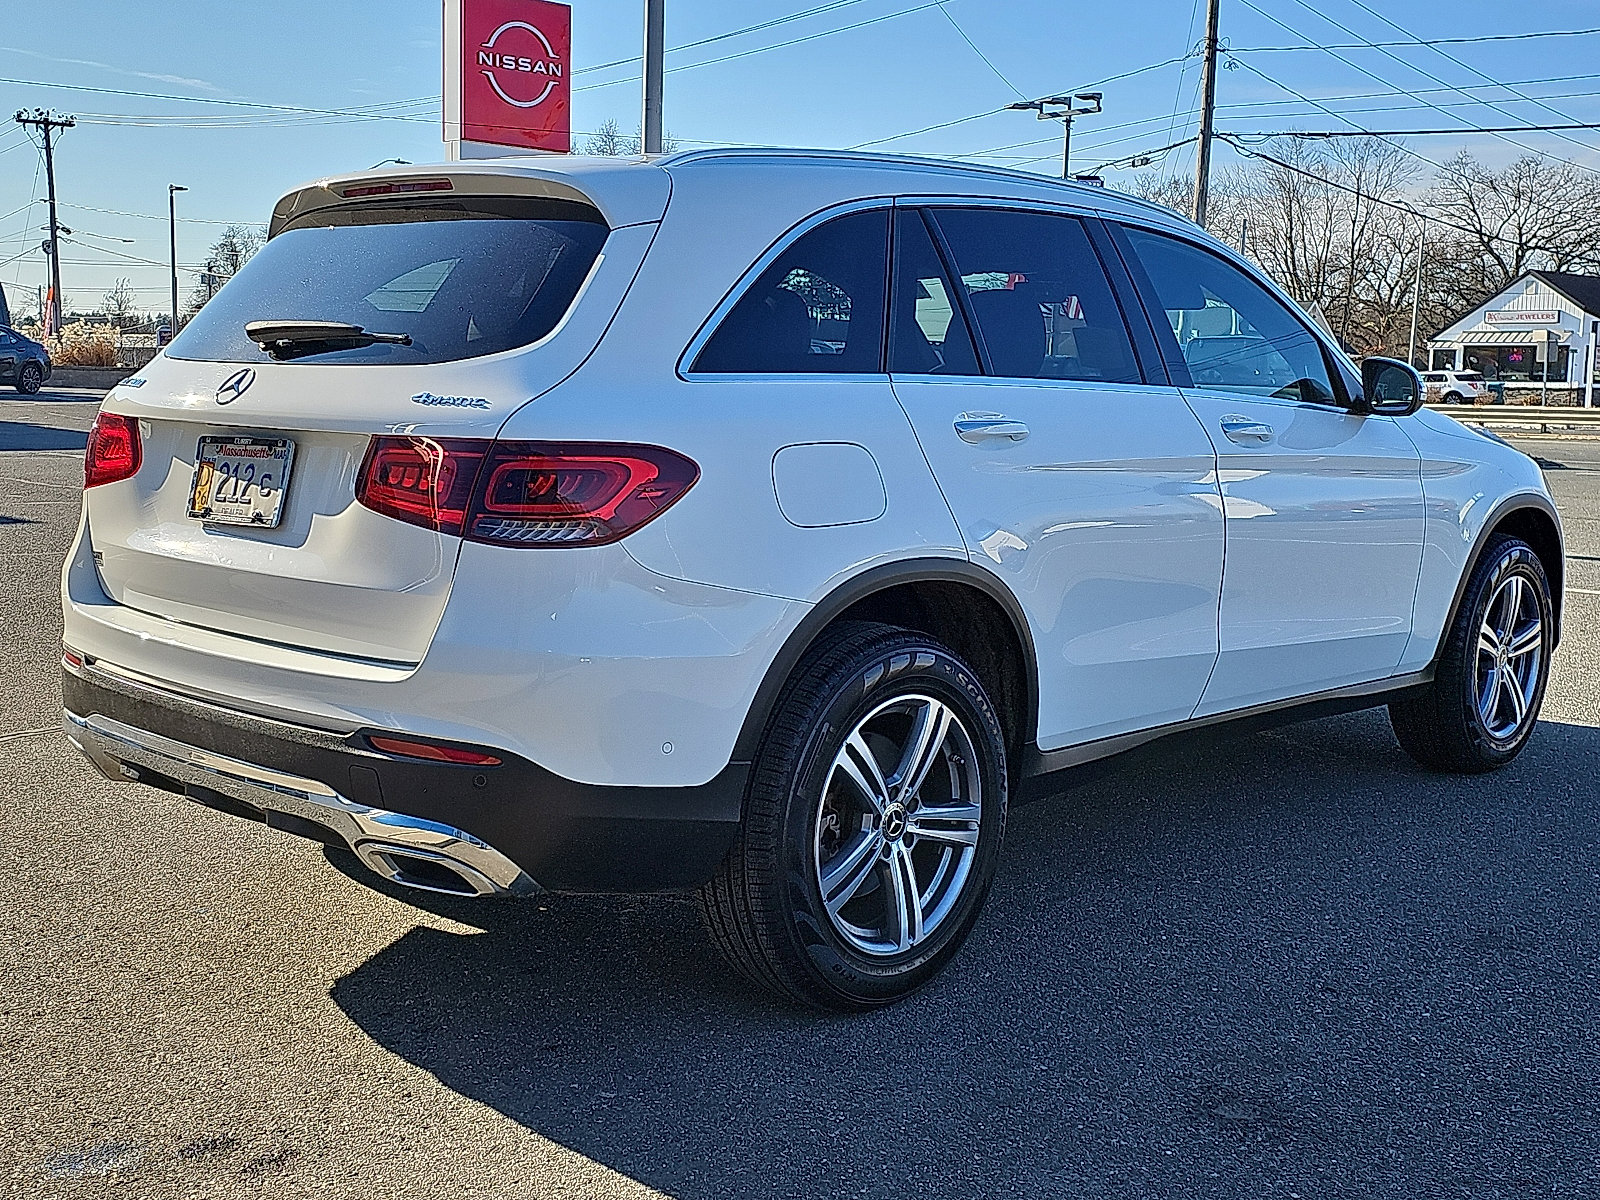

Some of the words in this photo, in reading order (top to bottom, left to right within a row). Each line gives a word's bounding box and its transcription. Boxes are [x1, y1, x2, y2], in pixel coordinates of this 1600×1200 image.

[477, 51, 562, 77] NISSAN
[219, 445, 269, 459] Massachusetts
[215, 462, 255, 504] 212
